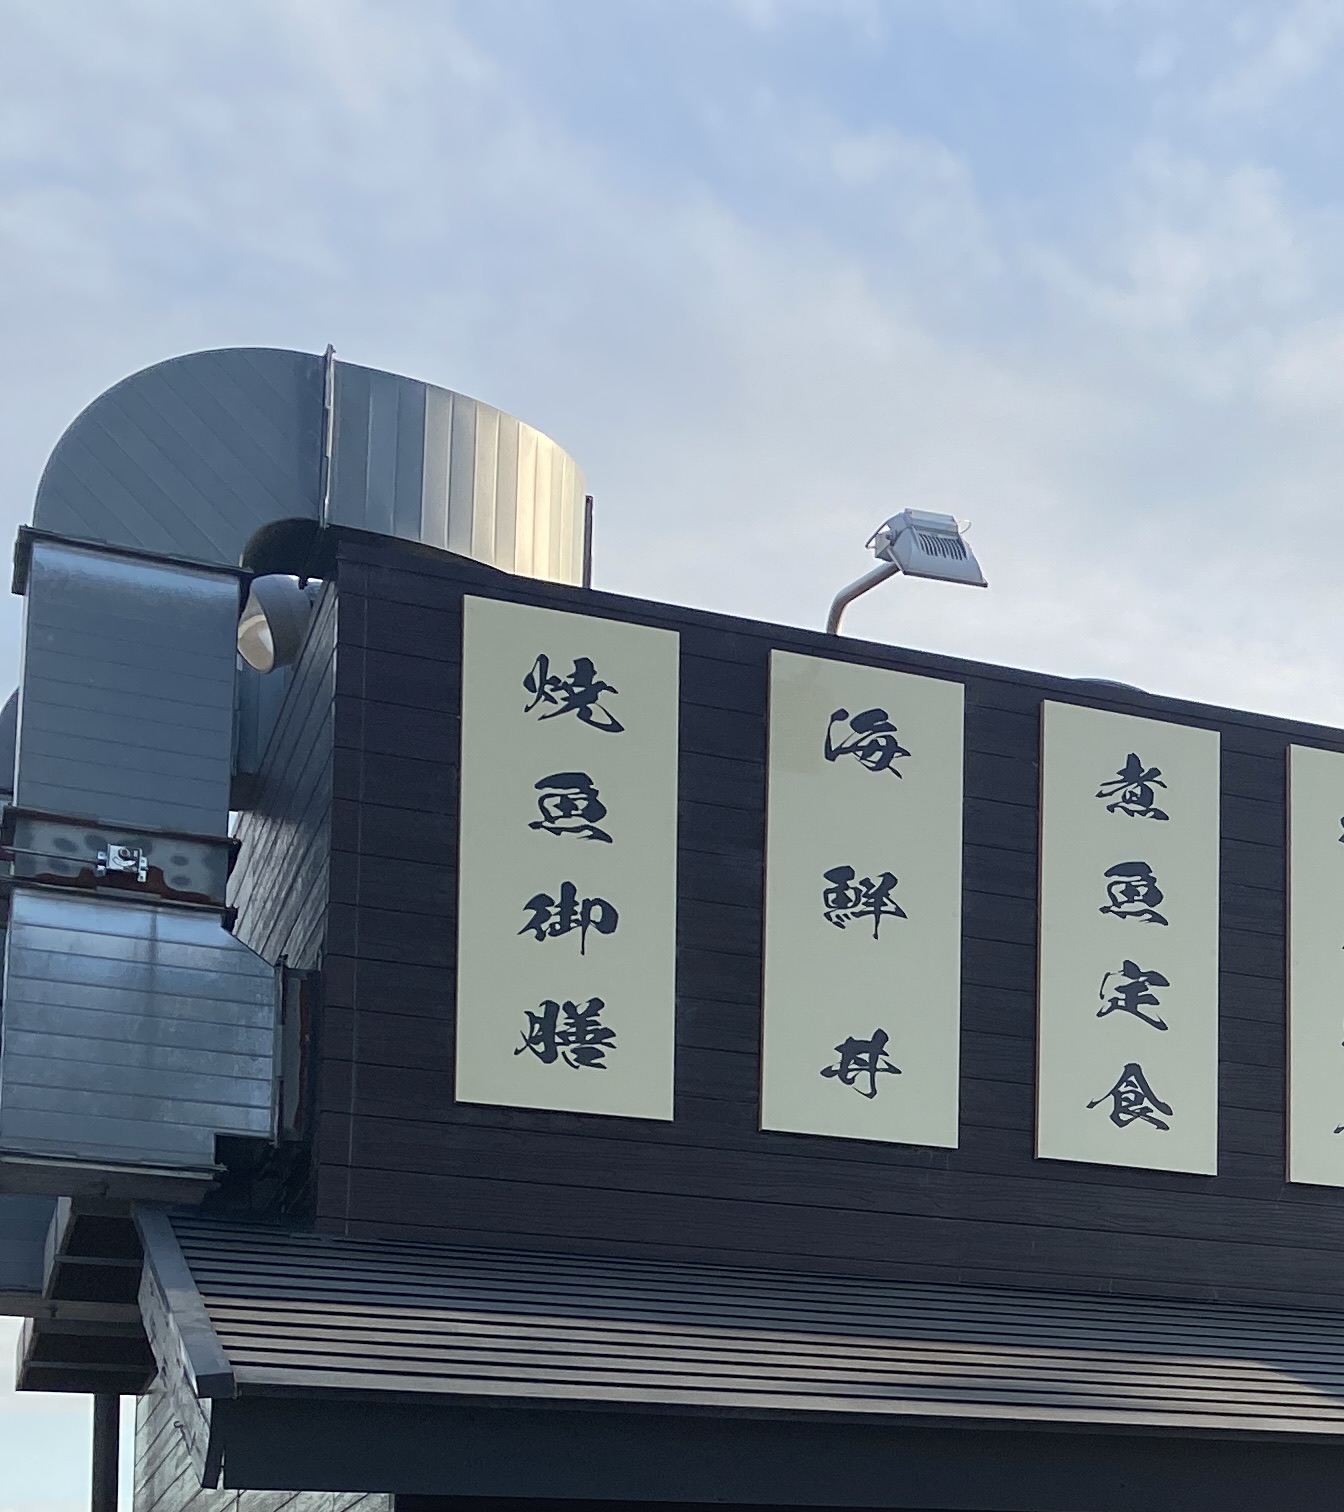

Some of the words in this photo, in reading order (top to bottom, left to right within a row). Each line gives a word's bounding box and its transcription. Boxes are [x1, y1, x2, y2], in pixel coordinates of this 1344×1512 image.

[514, 653, 625, 1070] 焼魚御膳
[820, 708, 912, 1099] 海鮮丼
[1086, 752, 1174, 1131] 煮魚定食
